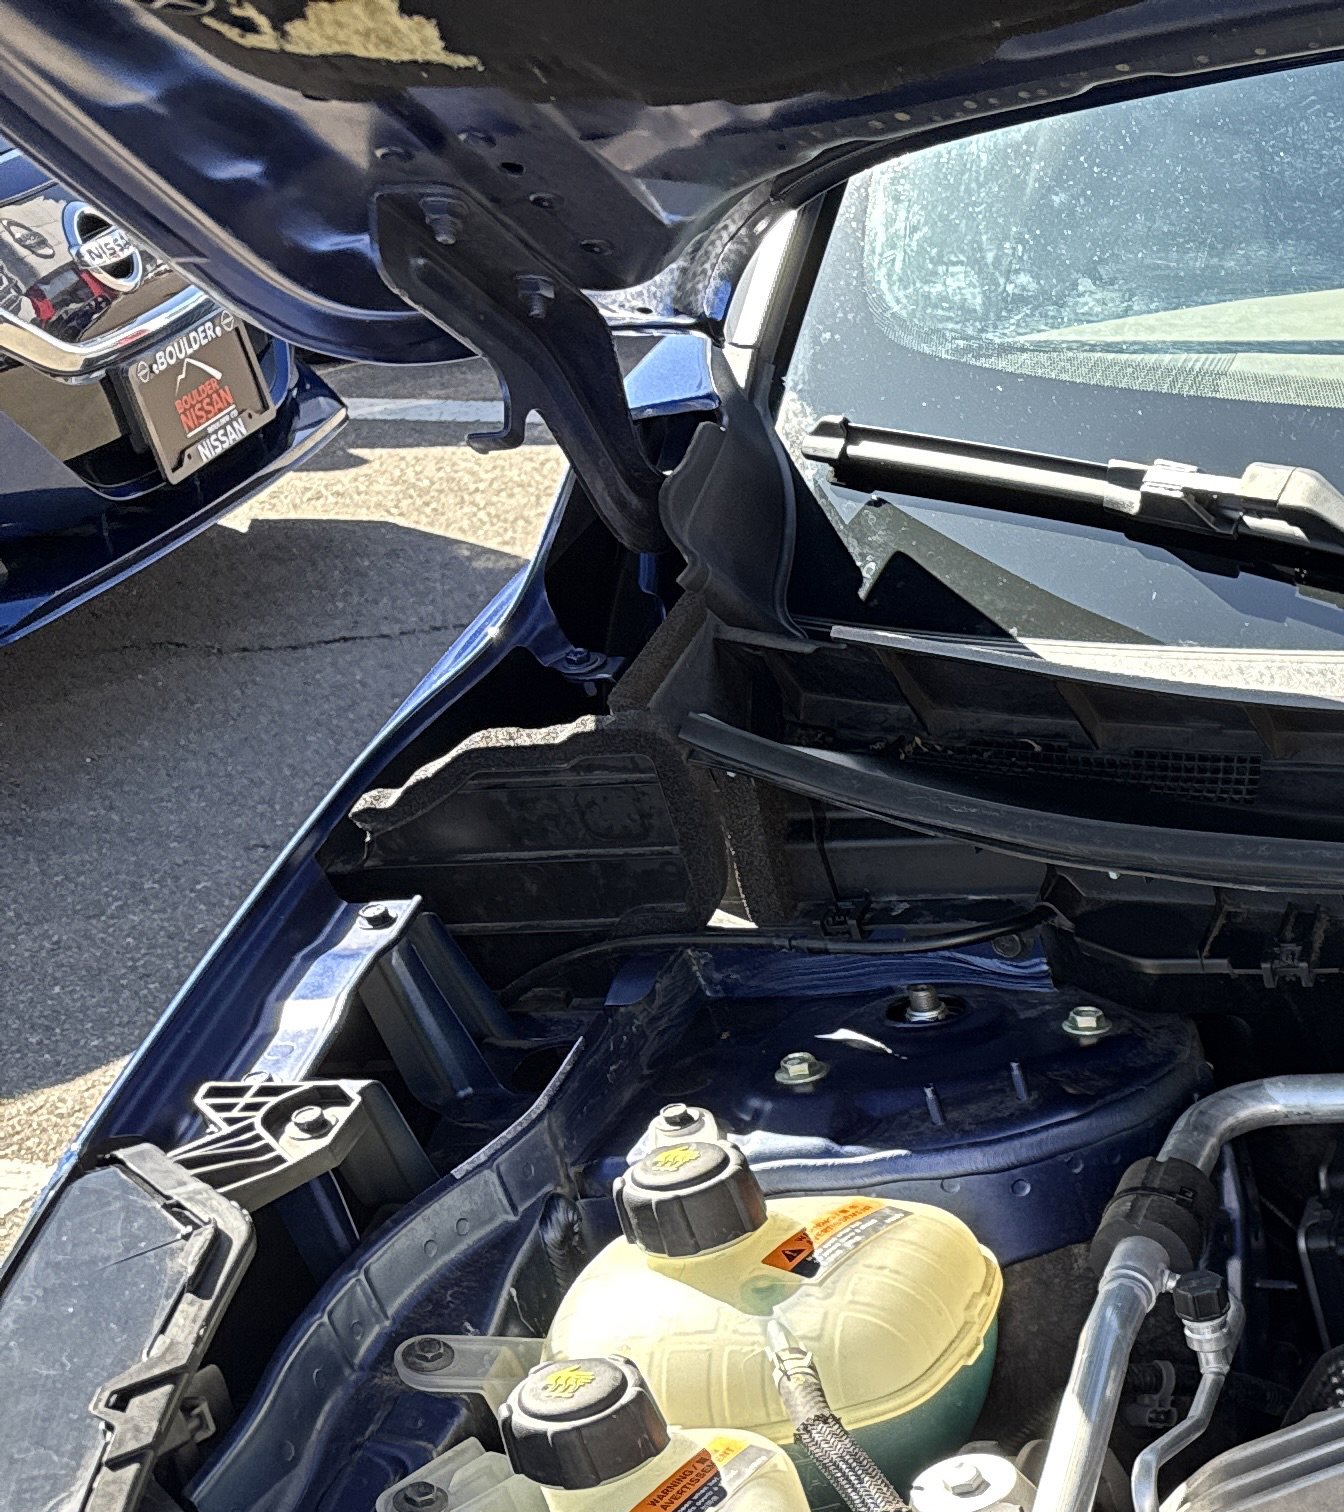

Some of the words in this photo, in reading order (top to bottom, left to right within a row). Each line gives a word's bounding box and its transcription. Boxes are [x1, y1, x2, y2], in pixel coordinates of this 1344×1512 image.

[155, 321, 218, 371] BOULDER
[174, 377, 220, 414] BOULDER
[180, 385, 235, 433] NISSAN
[197, 417, 248, 463] NISSAN
[647, 1469, 694, 1507] WARNING
